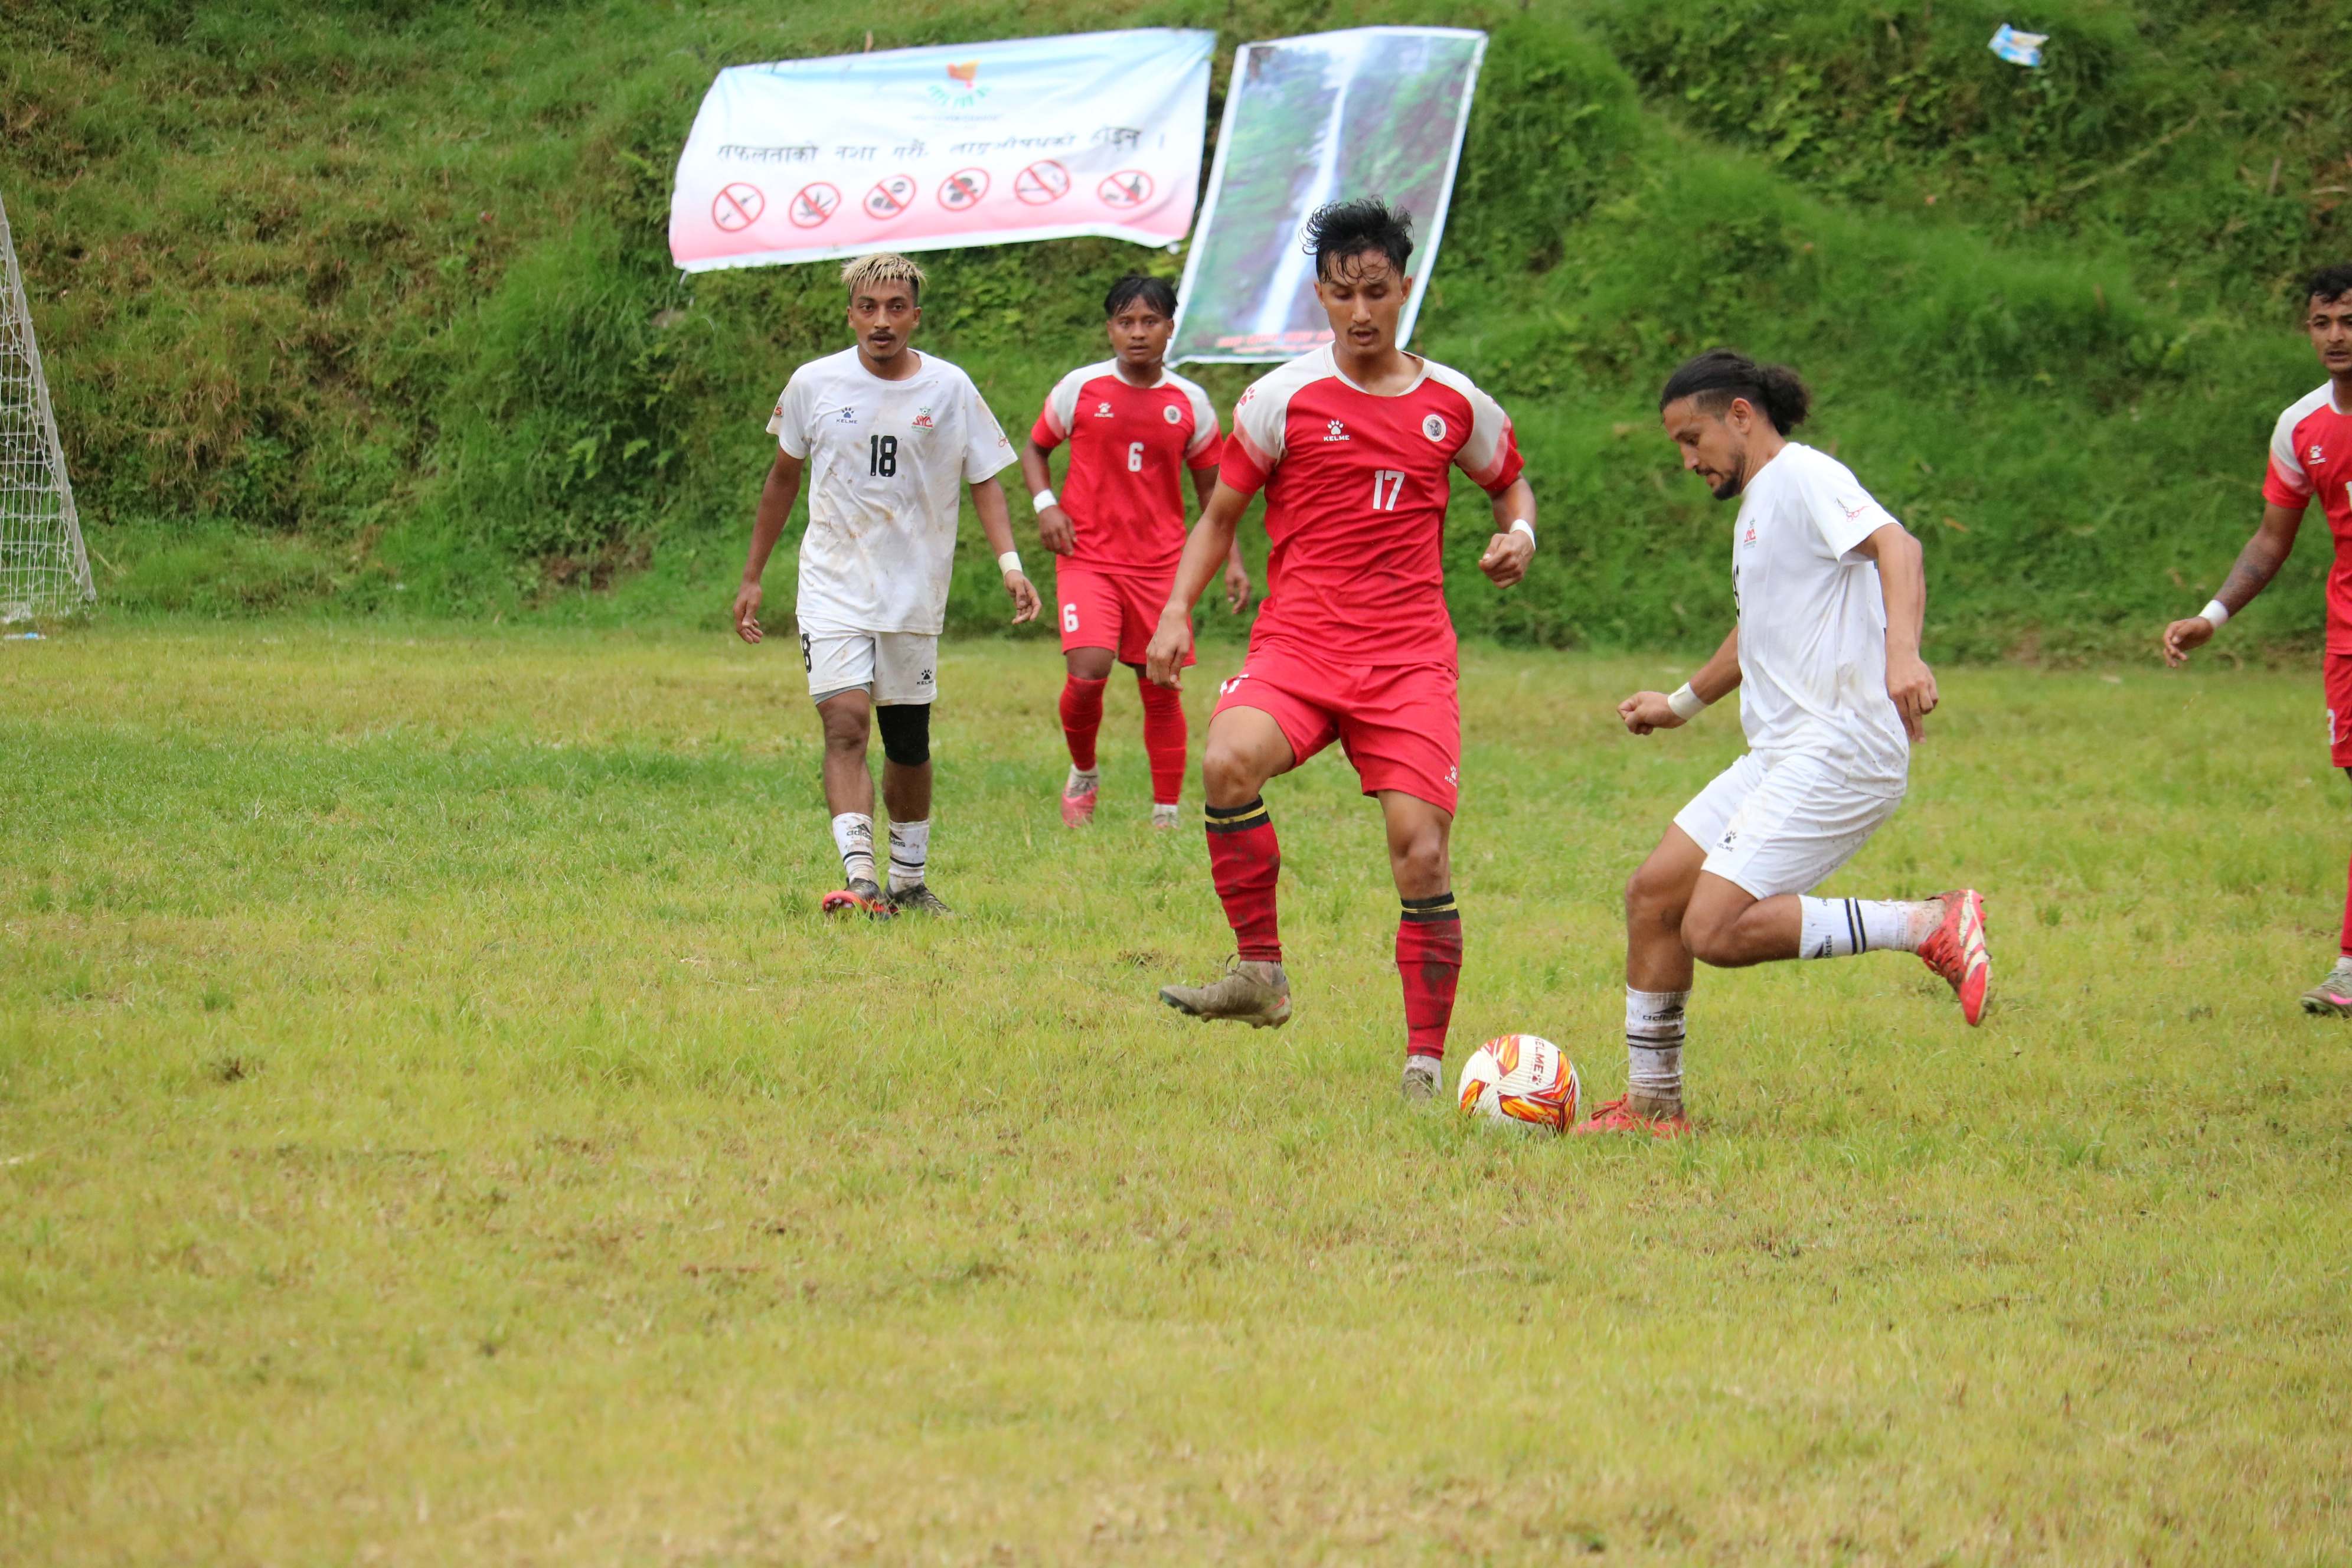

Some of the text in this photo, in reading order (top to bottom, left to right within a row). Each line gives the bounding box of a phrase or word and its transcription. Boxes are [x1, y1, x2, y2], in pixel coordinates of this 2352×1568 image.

[870, 435, 897, 478] 18
[1128, 442, 1144, 472] 6
[1373, 470, 1405, 511] 17
[1063, 603, 1079, 632] 6
